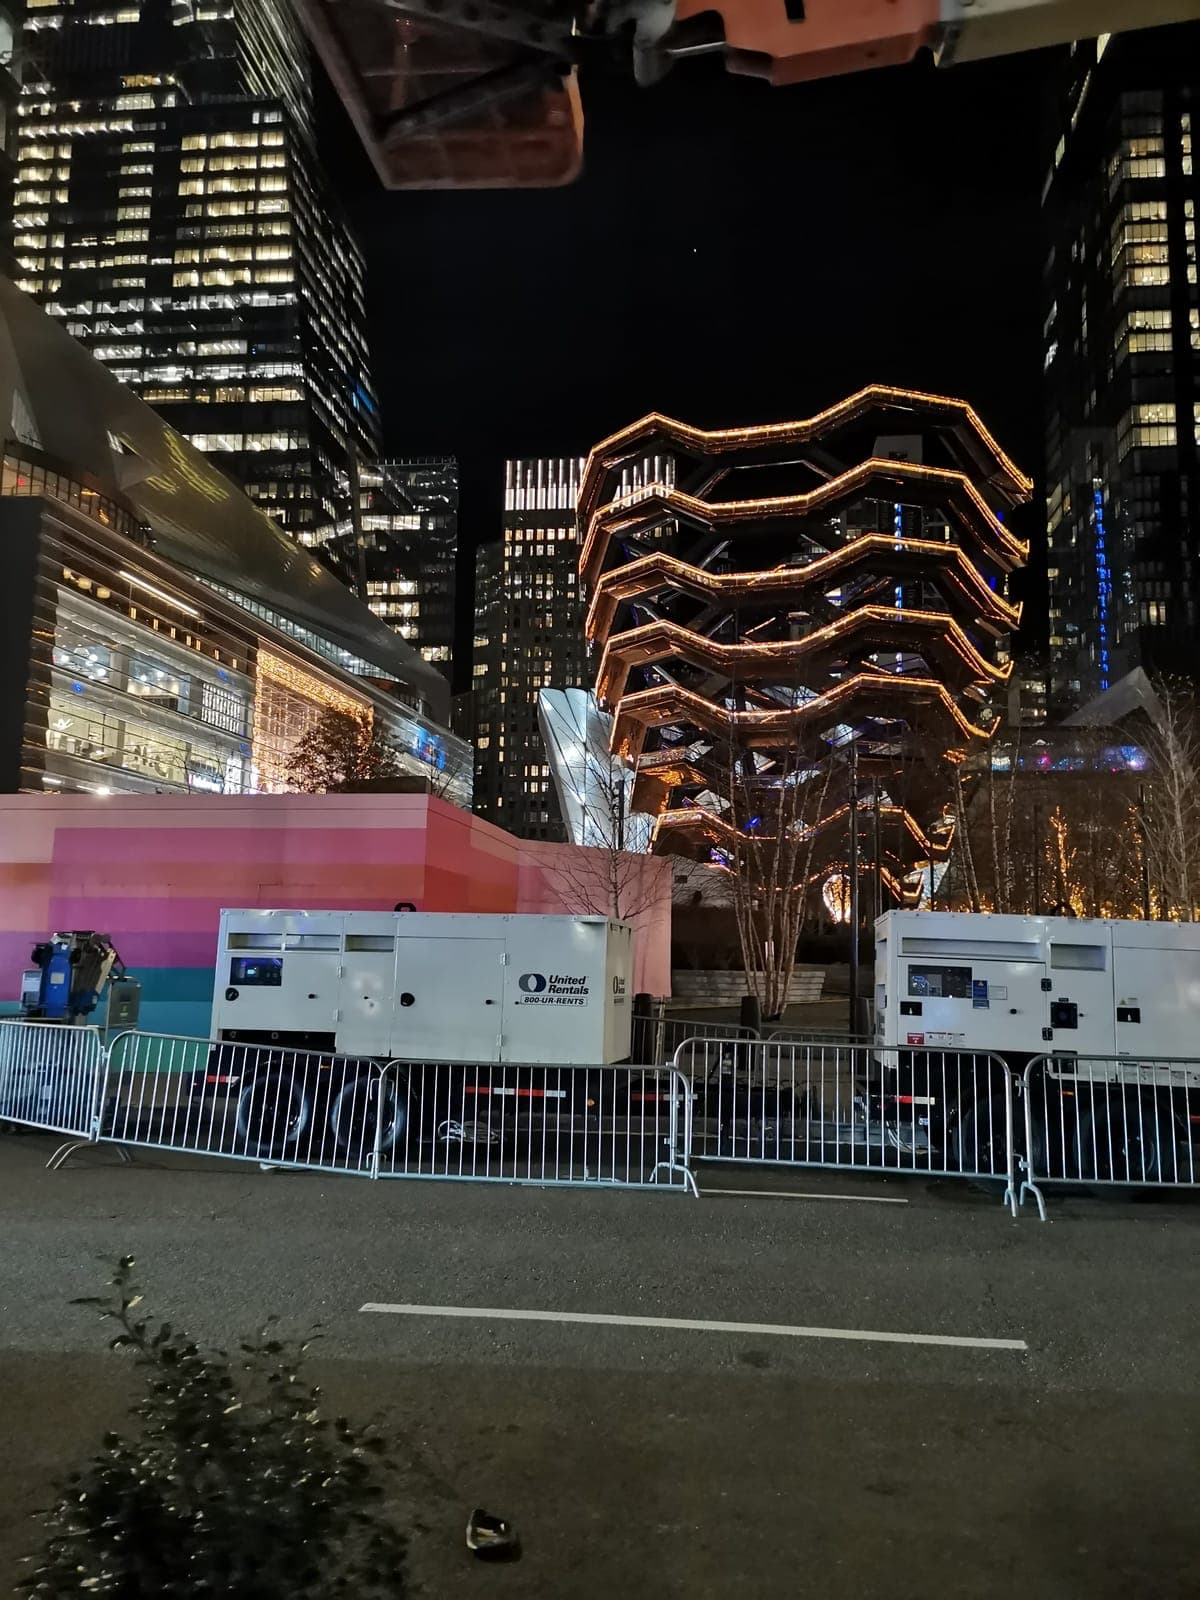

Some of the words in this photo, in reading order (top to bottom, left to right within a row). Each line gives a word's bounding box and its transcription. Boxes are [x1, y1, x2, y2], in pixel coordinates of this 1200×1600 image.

[549, 974, 586, 985] United
[548, 984, 589, 995] Rentals
[524, 996, 585, 1005] 800-UR-RENTS
